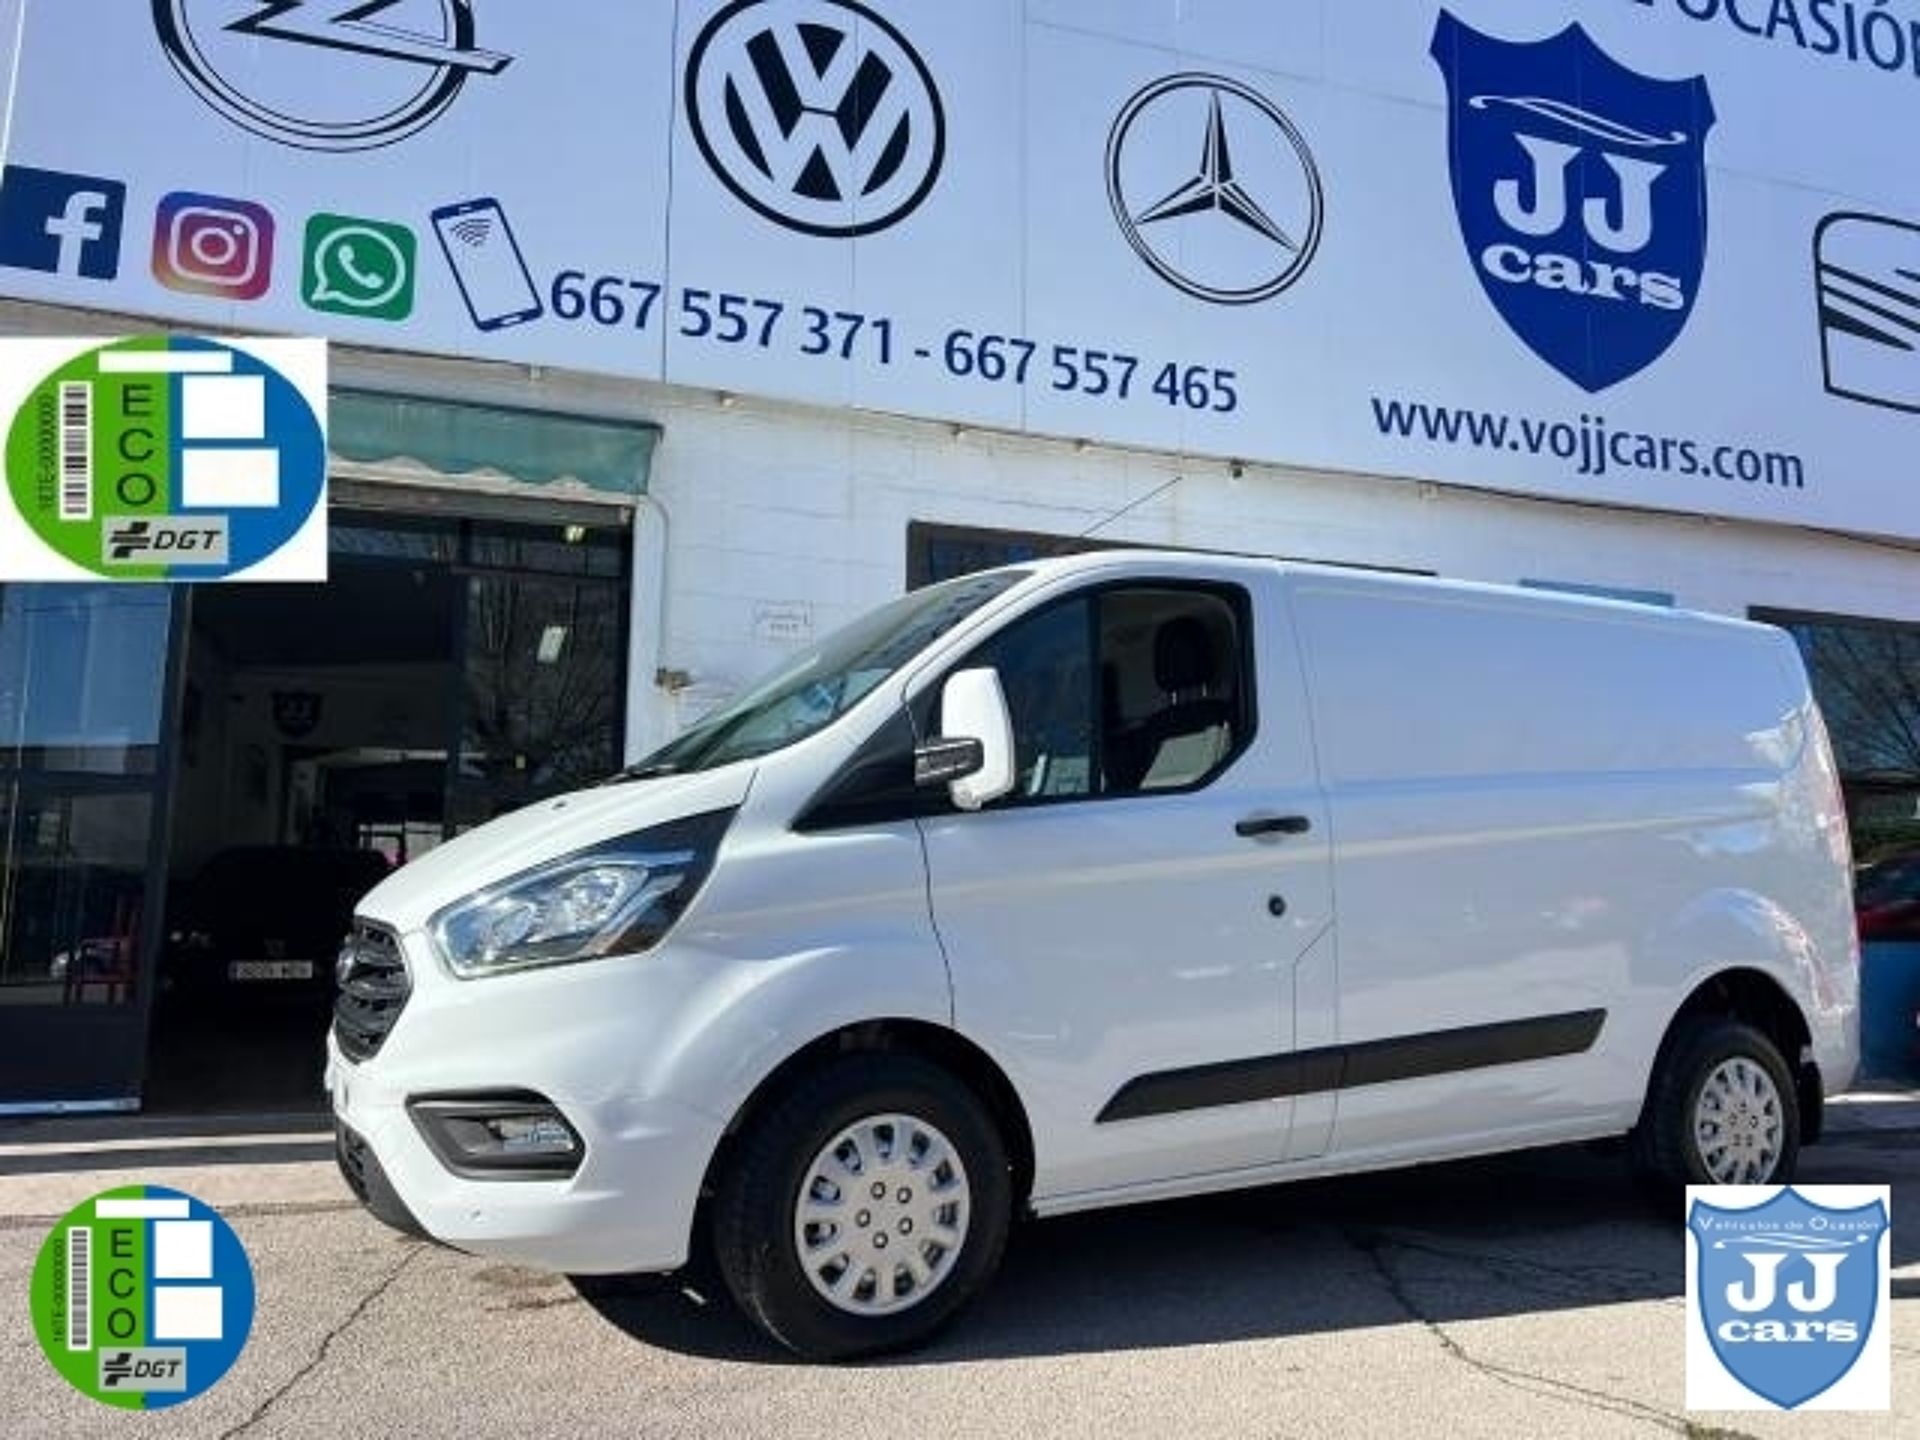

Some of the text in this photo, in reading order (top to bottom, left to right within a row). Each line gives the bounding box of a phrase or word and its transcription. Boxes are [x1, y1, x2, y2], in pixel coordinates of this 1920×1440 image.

[1676, 0, 1920, 78] CASIÓ
[1493, 132, 1668, 253] JJ
[1481, 243, 1684, 311] cars
[551, 270, 661, 330] 667
[680, 288, 783, 348] 557
[800, 307, 892, 364] 371
[945, 329, 1036, 384] 667
[1052, 345, 1138, 399] 557
[1152, 363, 1237, 412] 465
[1371, 398, 1804, 488] www.vojjcars.com
